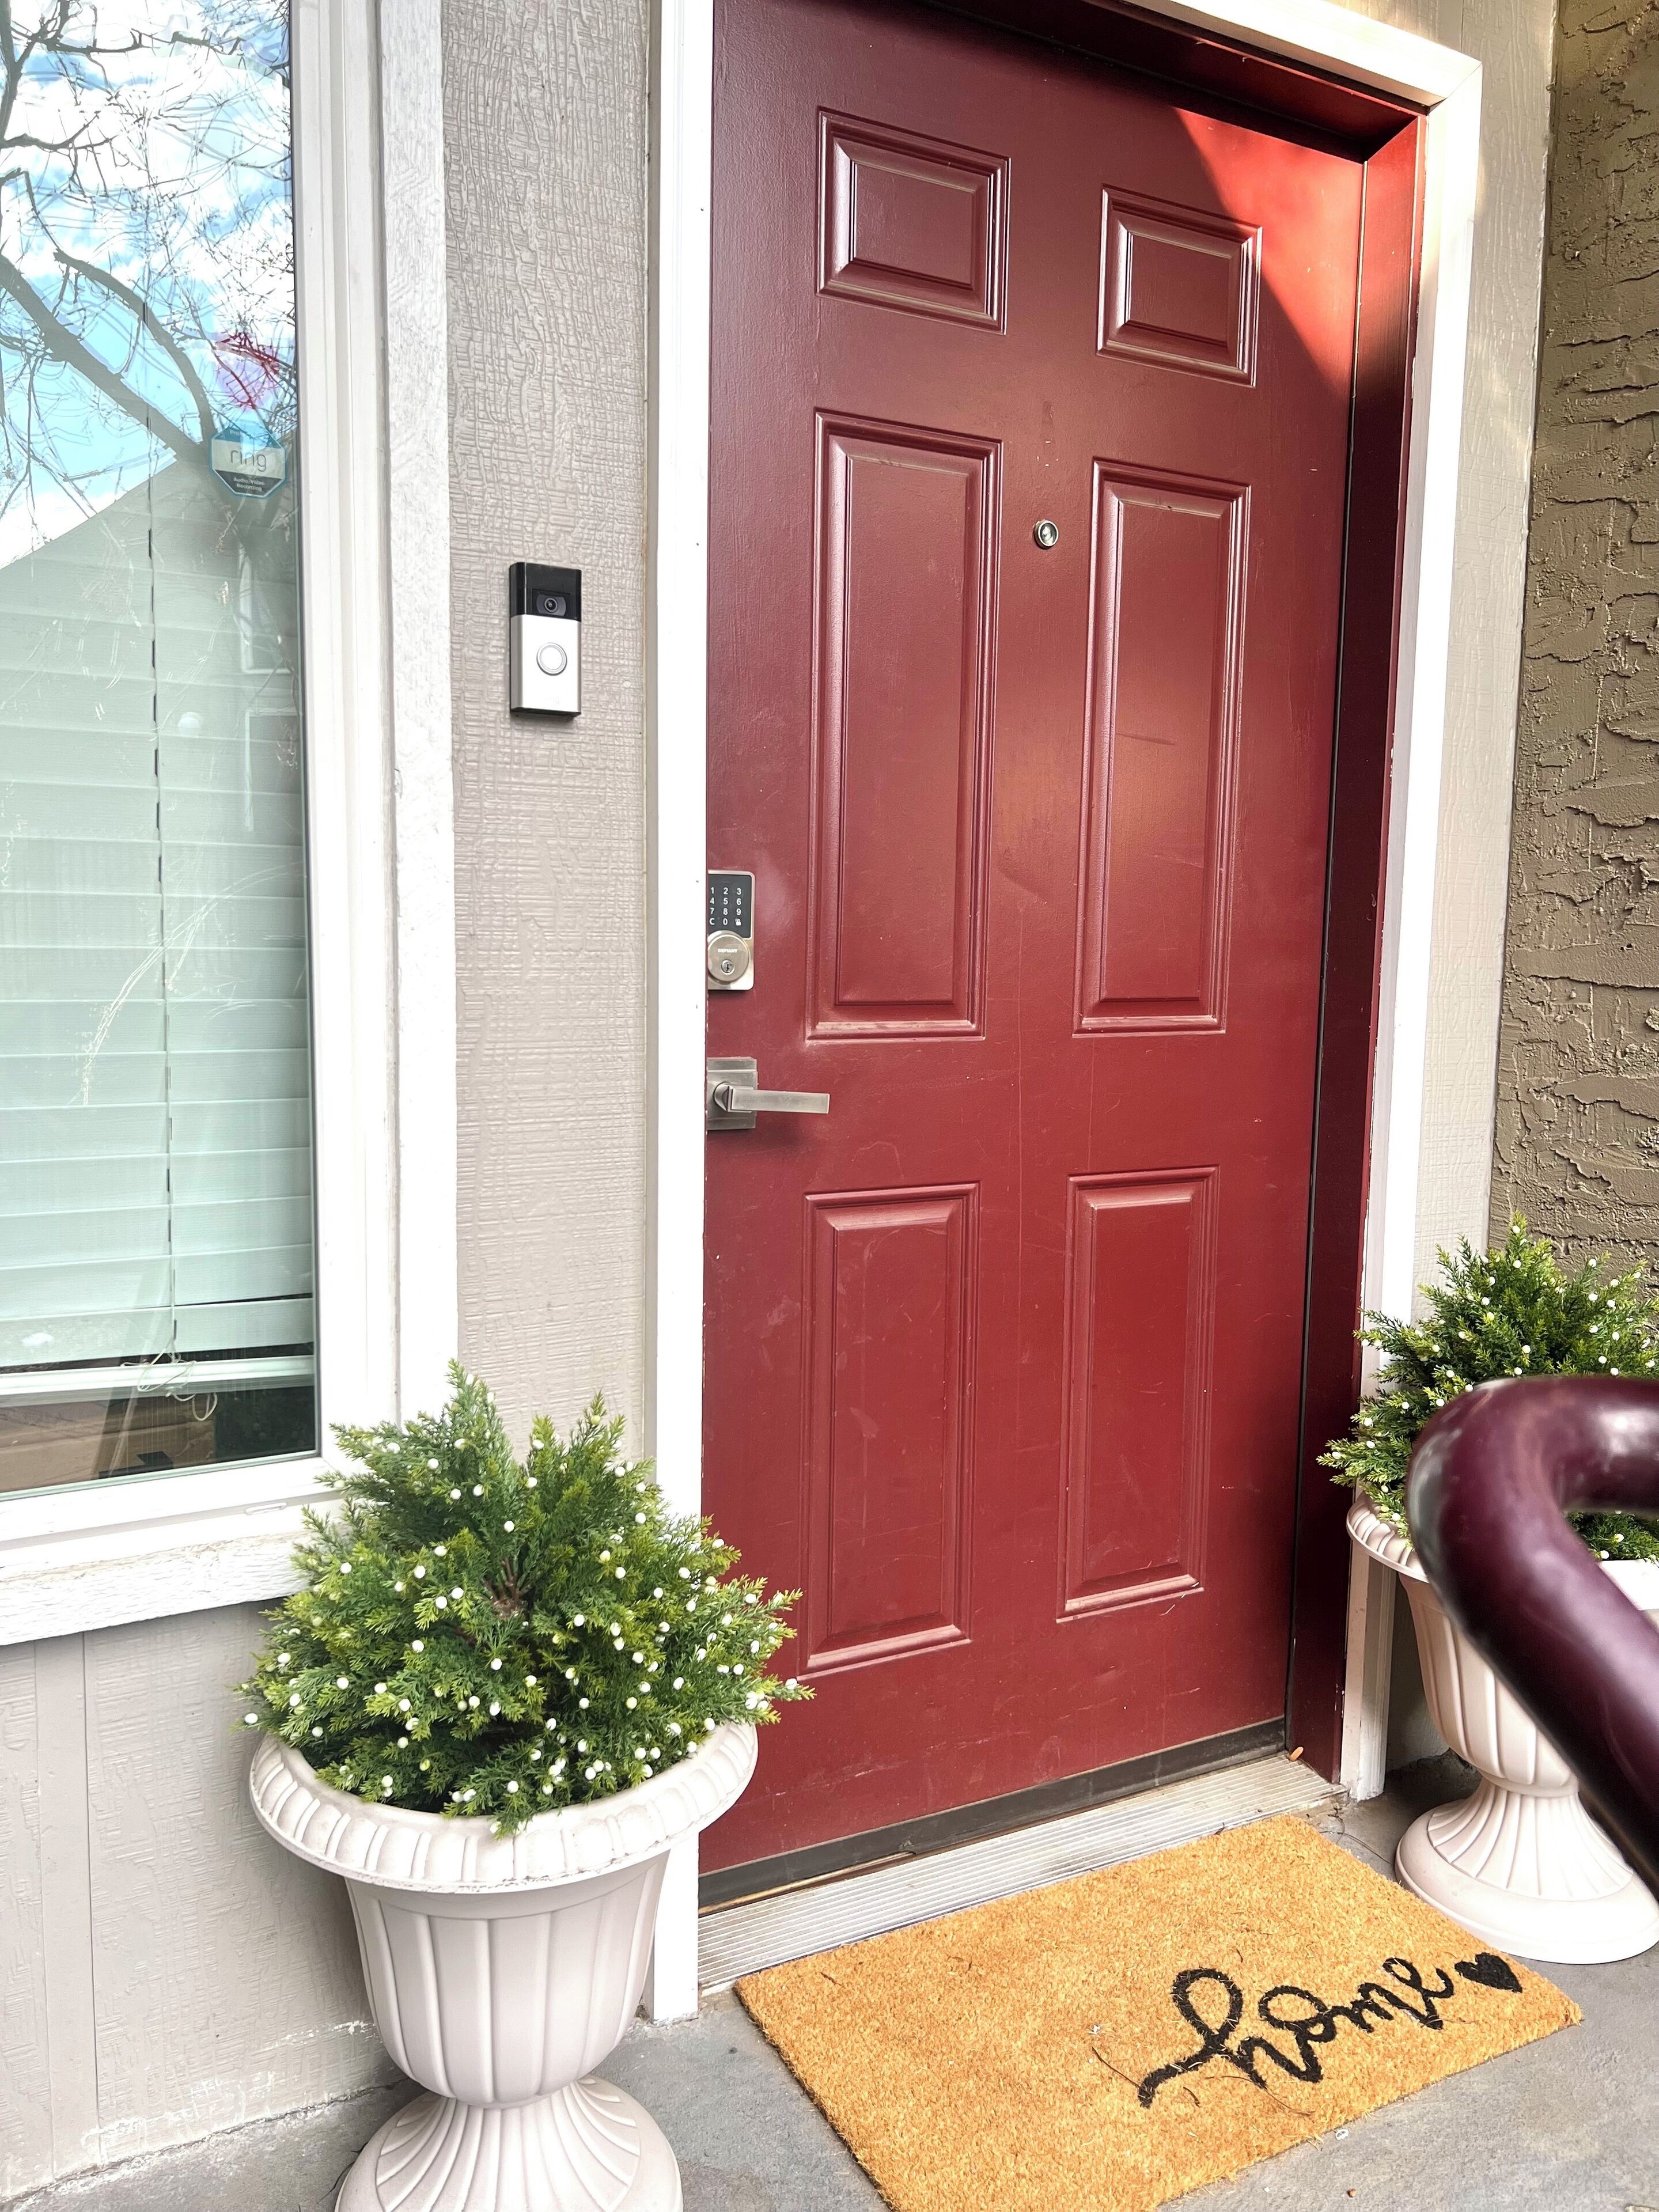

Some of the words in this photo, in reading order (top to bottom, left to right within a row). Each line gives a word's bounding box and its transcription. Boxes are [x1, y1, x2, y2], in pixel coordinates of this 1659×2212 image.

[231, 449, 267, 472] ring
[236, 483, 263, 492] Recording
[724, 887, 729, 895] 2
[723, 918, 728, 926] 0
[1137, 1957, 1455, 2109] home
